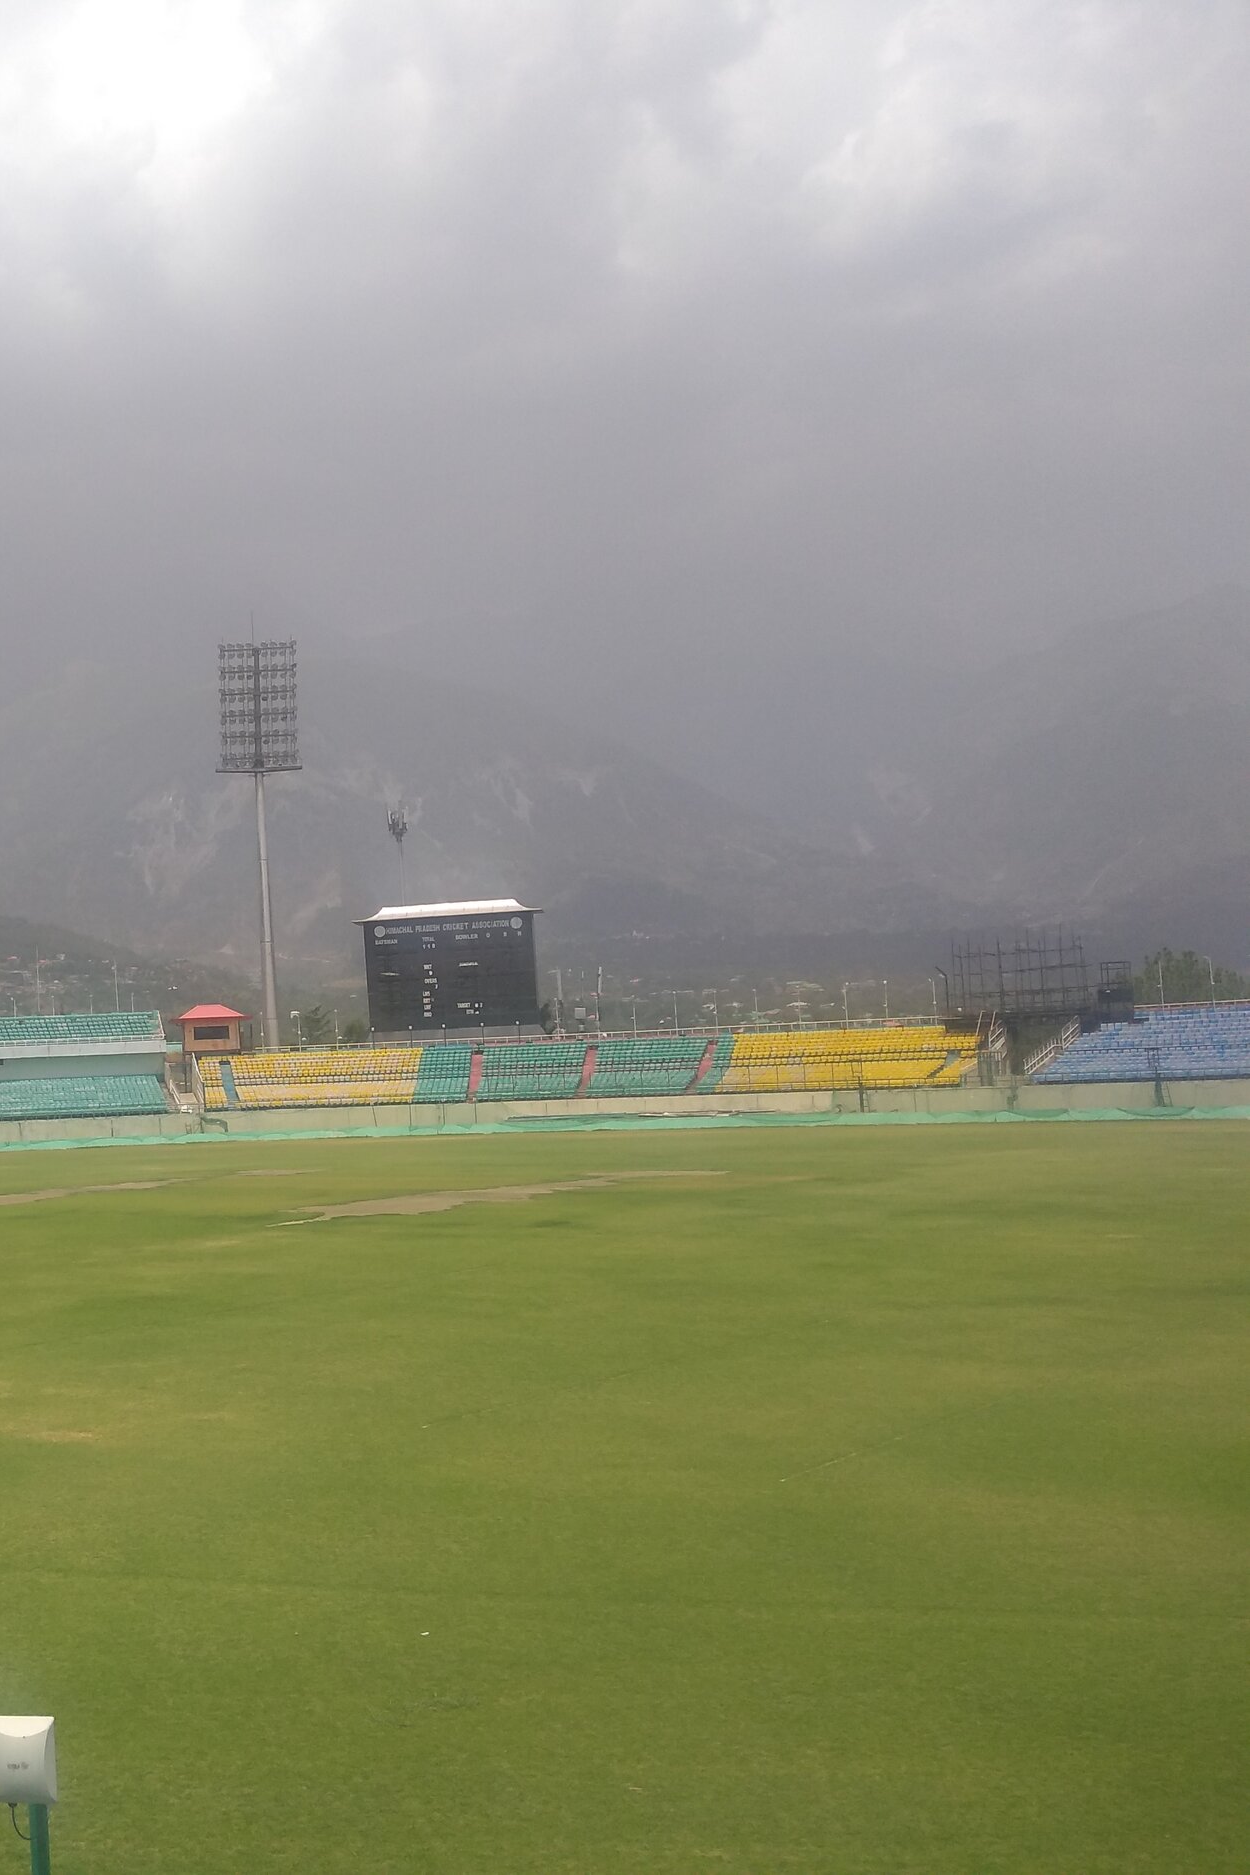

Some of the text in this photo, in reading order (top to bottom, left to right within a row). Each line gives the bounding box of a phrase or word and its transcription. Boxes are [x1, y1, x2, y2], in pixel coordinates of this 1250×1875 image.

[415, 924, 441, 933] PRADESH
[442, 922, 469, 931] CRICKET
[471, 919, 510, 929] ASSOCIATION
[455, 933, 478, 941] BOWLER
